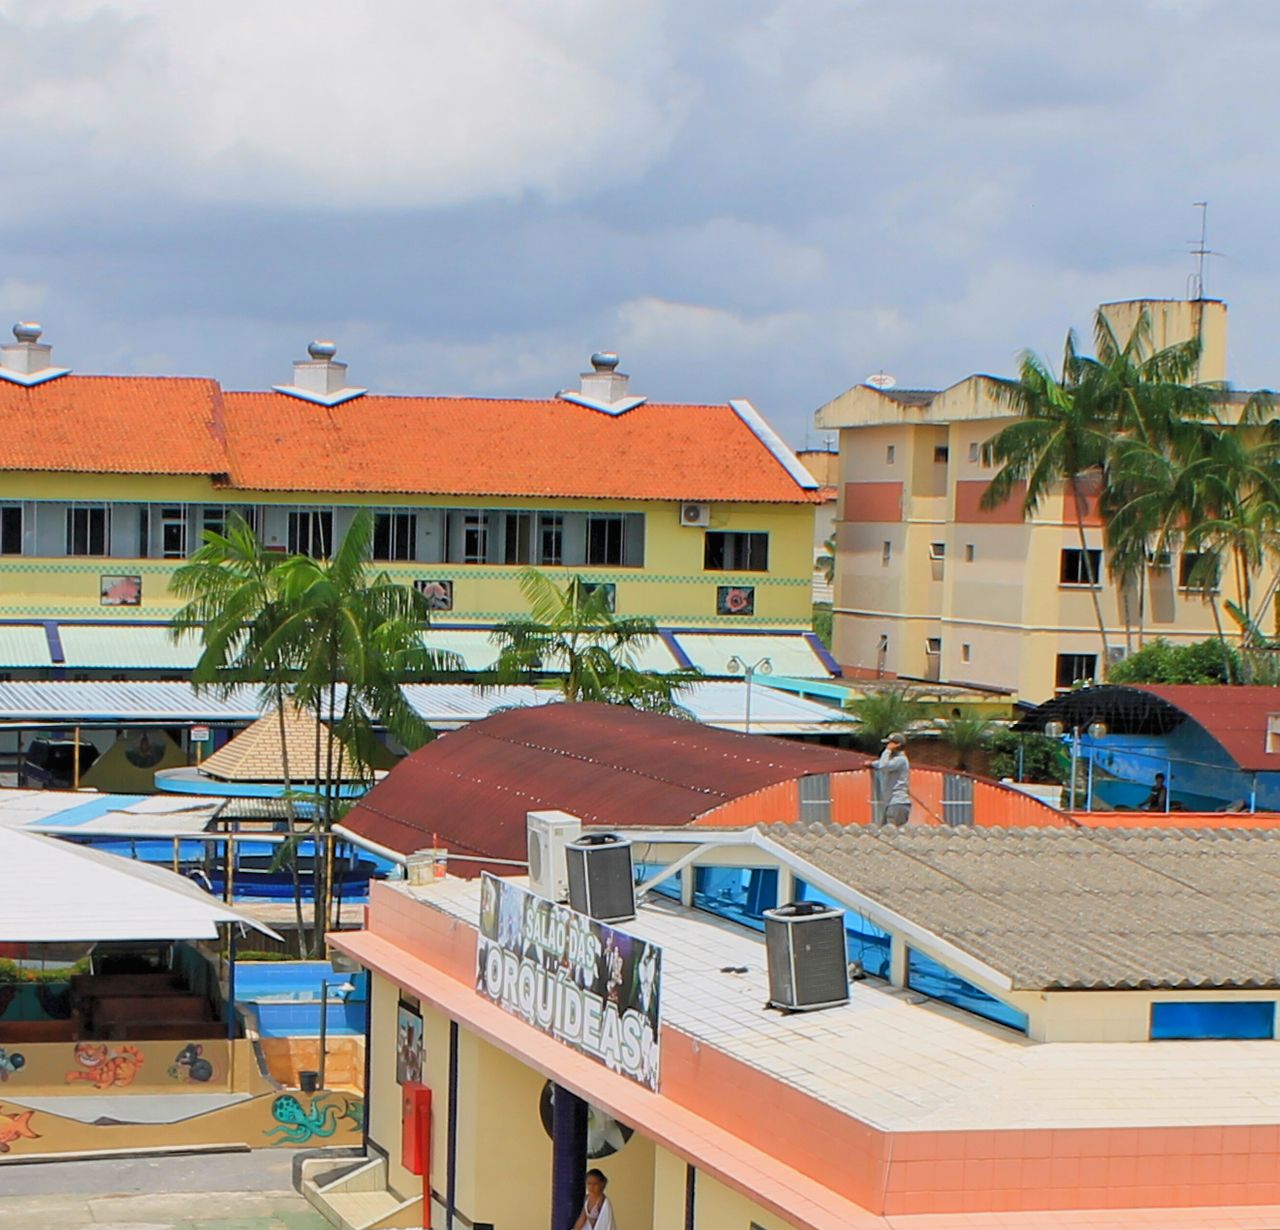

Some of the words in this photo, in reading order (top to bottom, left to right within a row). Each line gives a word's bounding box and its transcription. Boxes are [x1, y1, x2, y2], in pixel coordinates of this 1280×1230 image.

[525, 907, 566, 956] SALÃO
[569, 925, 595, 969] DAS
[486, 946, 643, 1072] ORQUÍDEAS
